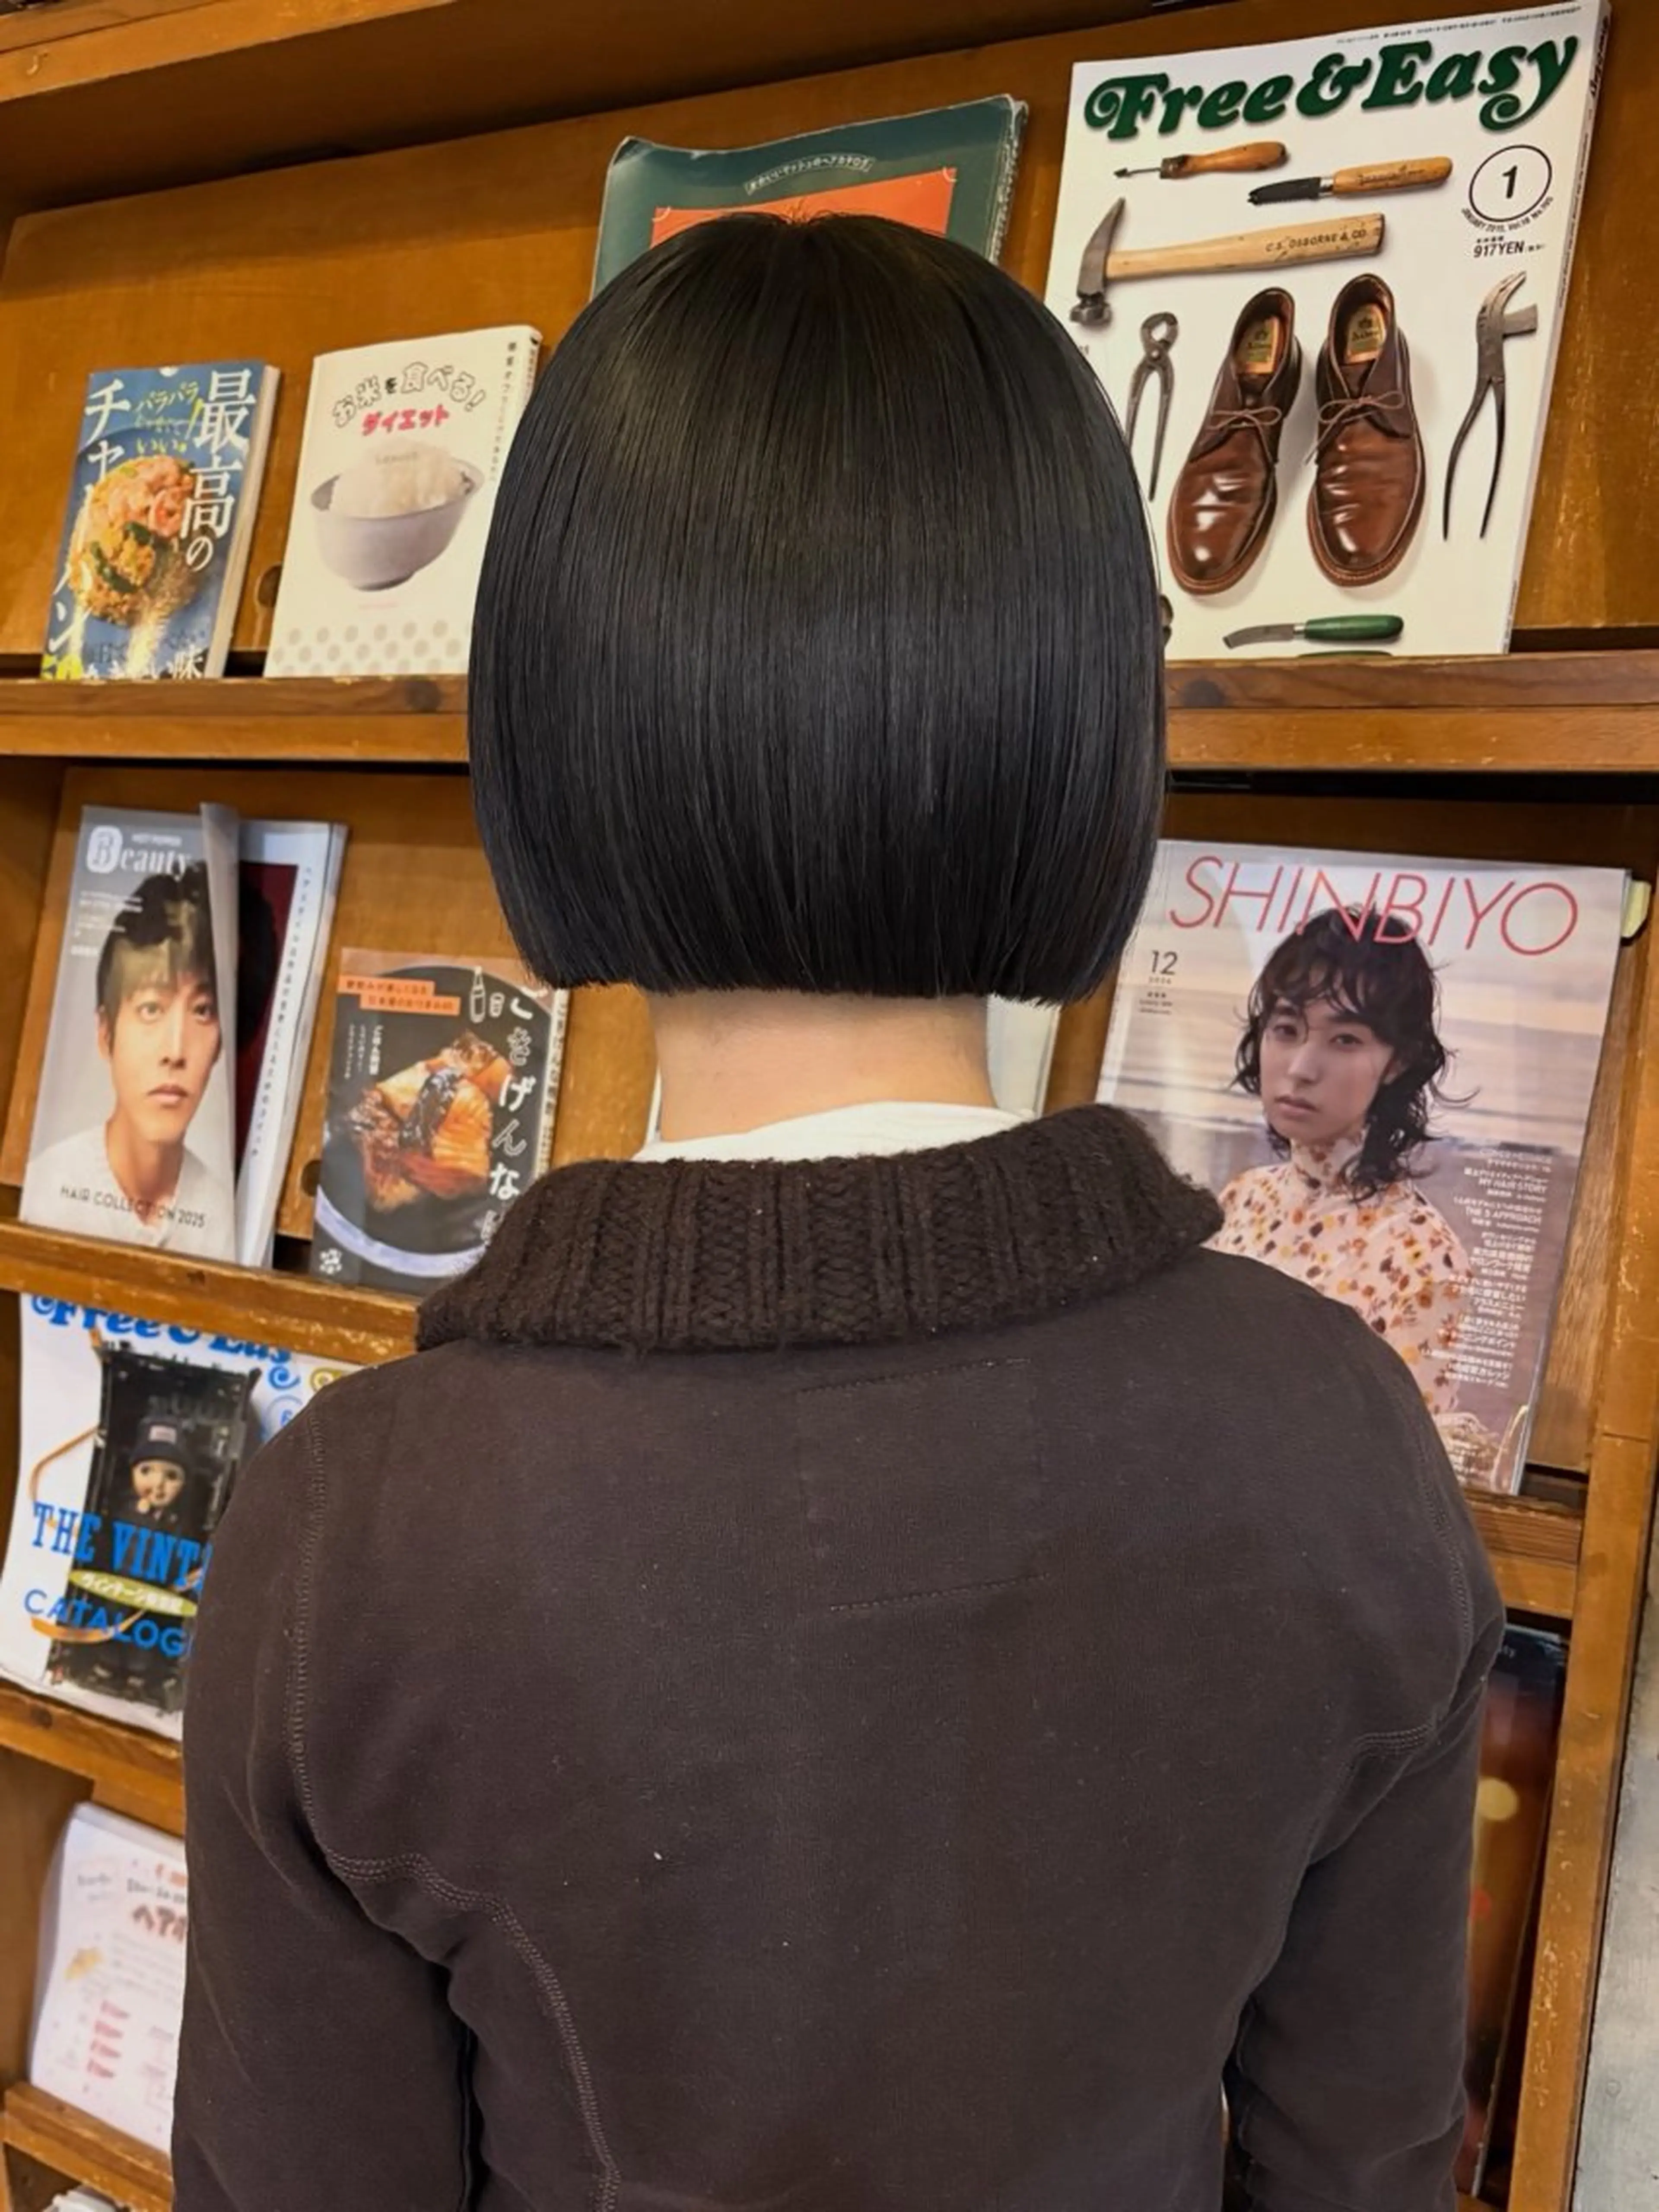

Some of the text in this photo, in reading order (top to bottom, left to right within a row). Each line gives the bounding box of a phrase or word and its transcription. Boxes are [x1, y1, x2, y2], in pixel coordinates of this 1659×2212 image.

[1503, 165, 1517, 199] 1
[362, 404, 449, 436] ダイエット
[180, 369, 255, 572] 最高の
[86, 825, 193, 882] Beauty
[1170, 856, 1579, 955] SHINBIYO
[1152, 950, 1177, 975] 12
[60, 1186, 90, 1201] HAIR
[32, 1501, 102, 1563] THE
